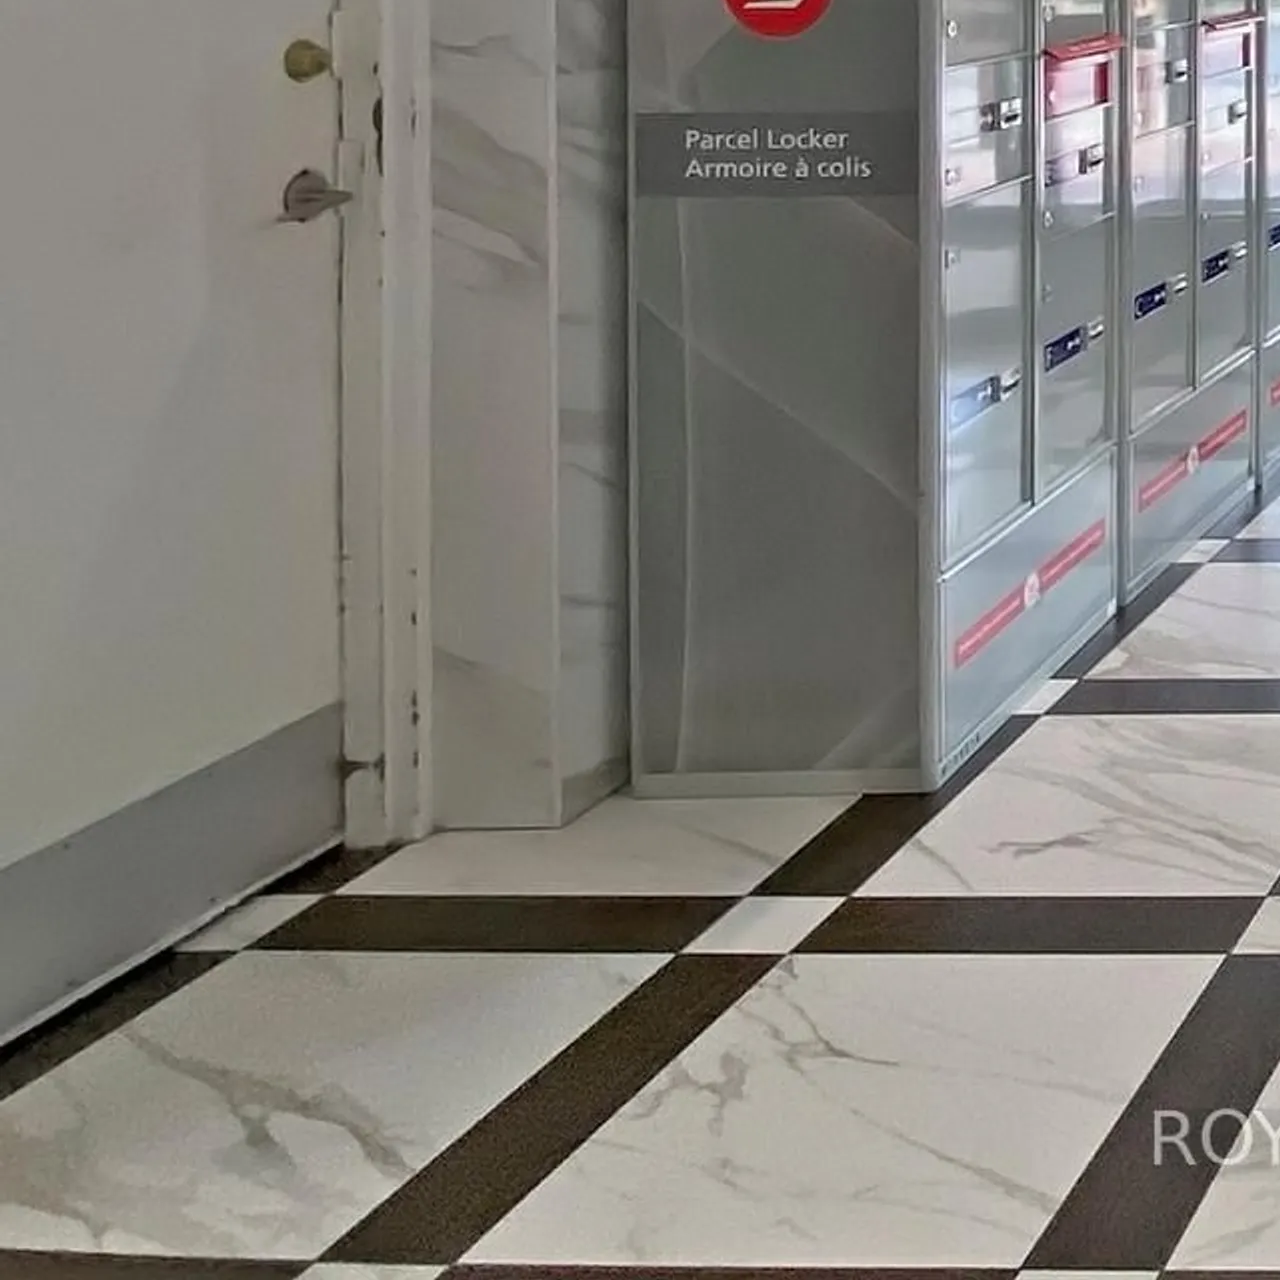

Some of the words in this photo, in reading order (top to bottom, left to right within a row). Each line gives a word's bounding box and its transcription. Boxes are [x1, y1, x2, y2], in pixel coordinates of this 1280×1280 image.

[685, 128, 758, 149] Parcel
[767, 128, 849, 149] Locker
[685, 157, 787, 178] Armoire
[795, 158, 808, 178] à
[817, 156, 872, 178] colis
